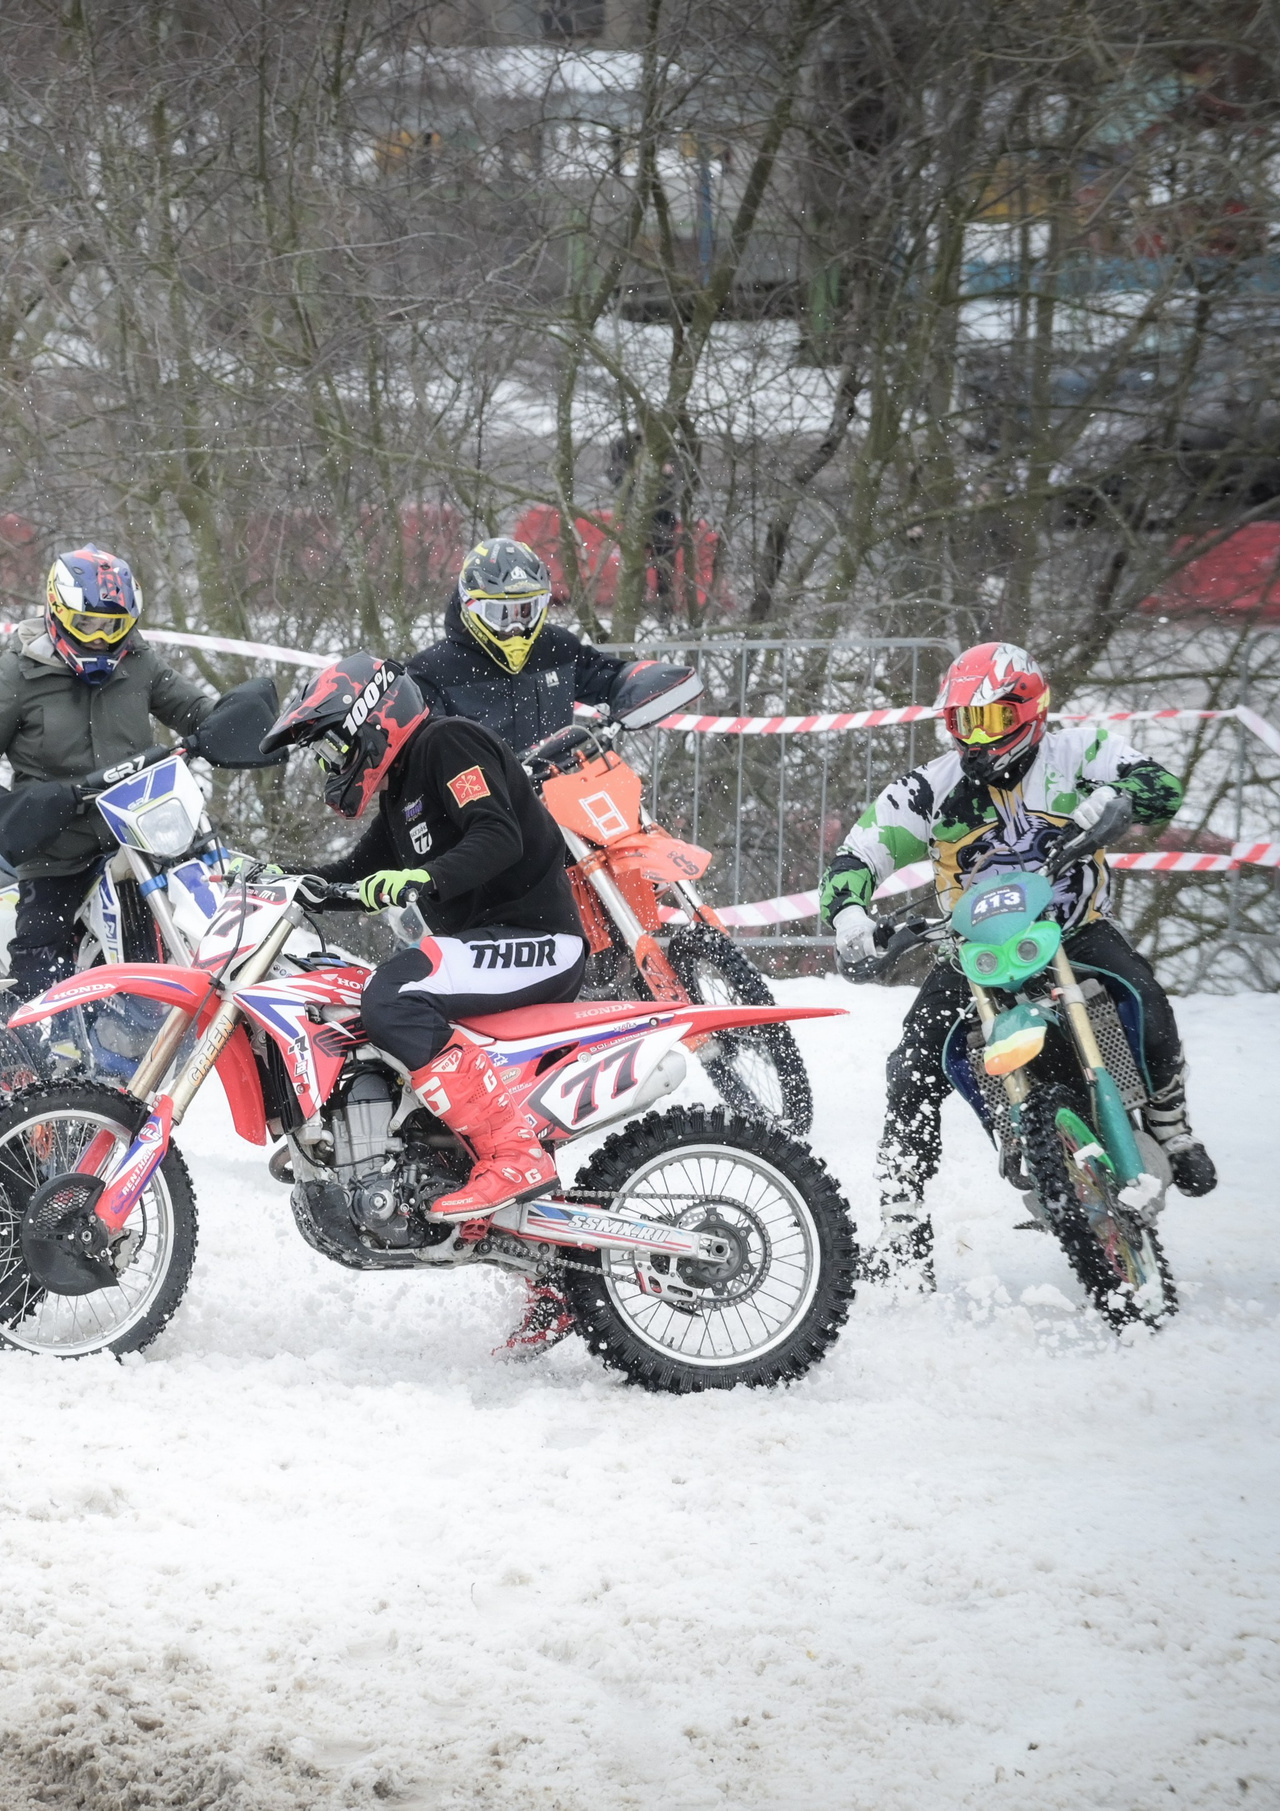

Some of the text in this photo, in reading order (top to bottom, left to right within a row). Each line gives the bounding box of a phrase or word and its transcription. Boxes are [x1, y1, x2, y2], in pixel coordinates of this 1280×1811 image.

[342, 664, 395, 736] 100%
[103, 755, 145, 783] GR7
[974, 892, 1021, 914] 413
[470, 938, 557, 969] THOR
[53, 983, 117, 1000] HONDA
[574, 1003, 635, 1019] HONDA
[188, 1014, 235, 1087] GREEN
[561, 1038, 645, 1125] 77
[122, 1149, 154, 1196] RENTHAL
[567, 1215, 671, 1243] SSMX.RU
